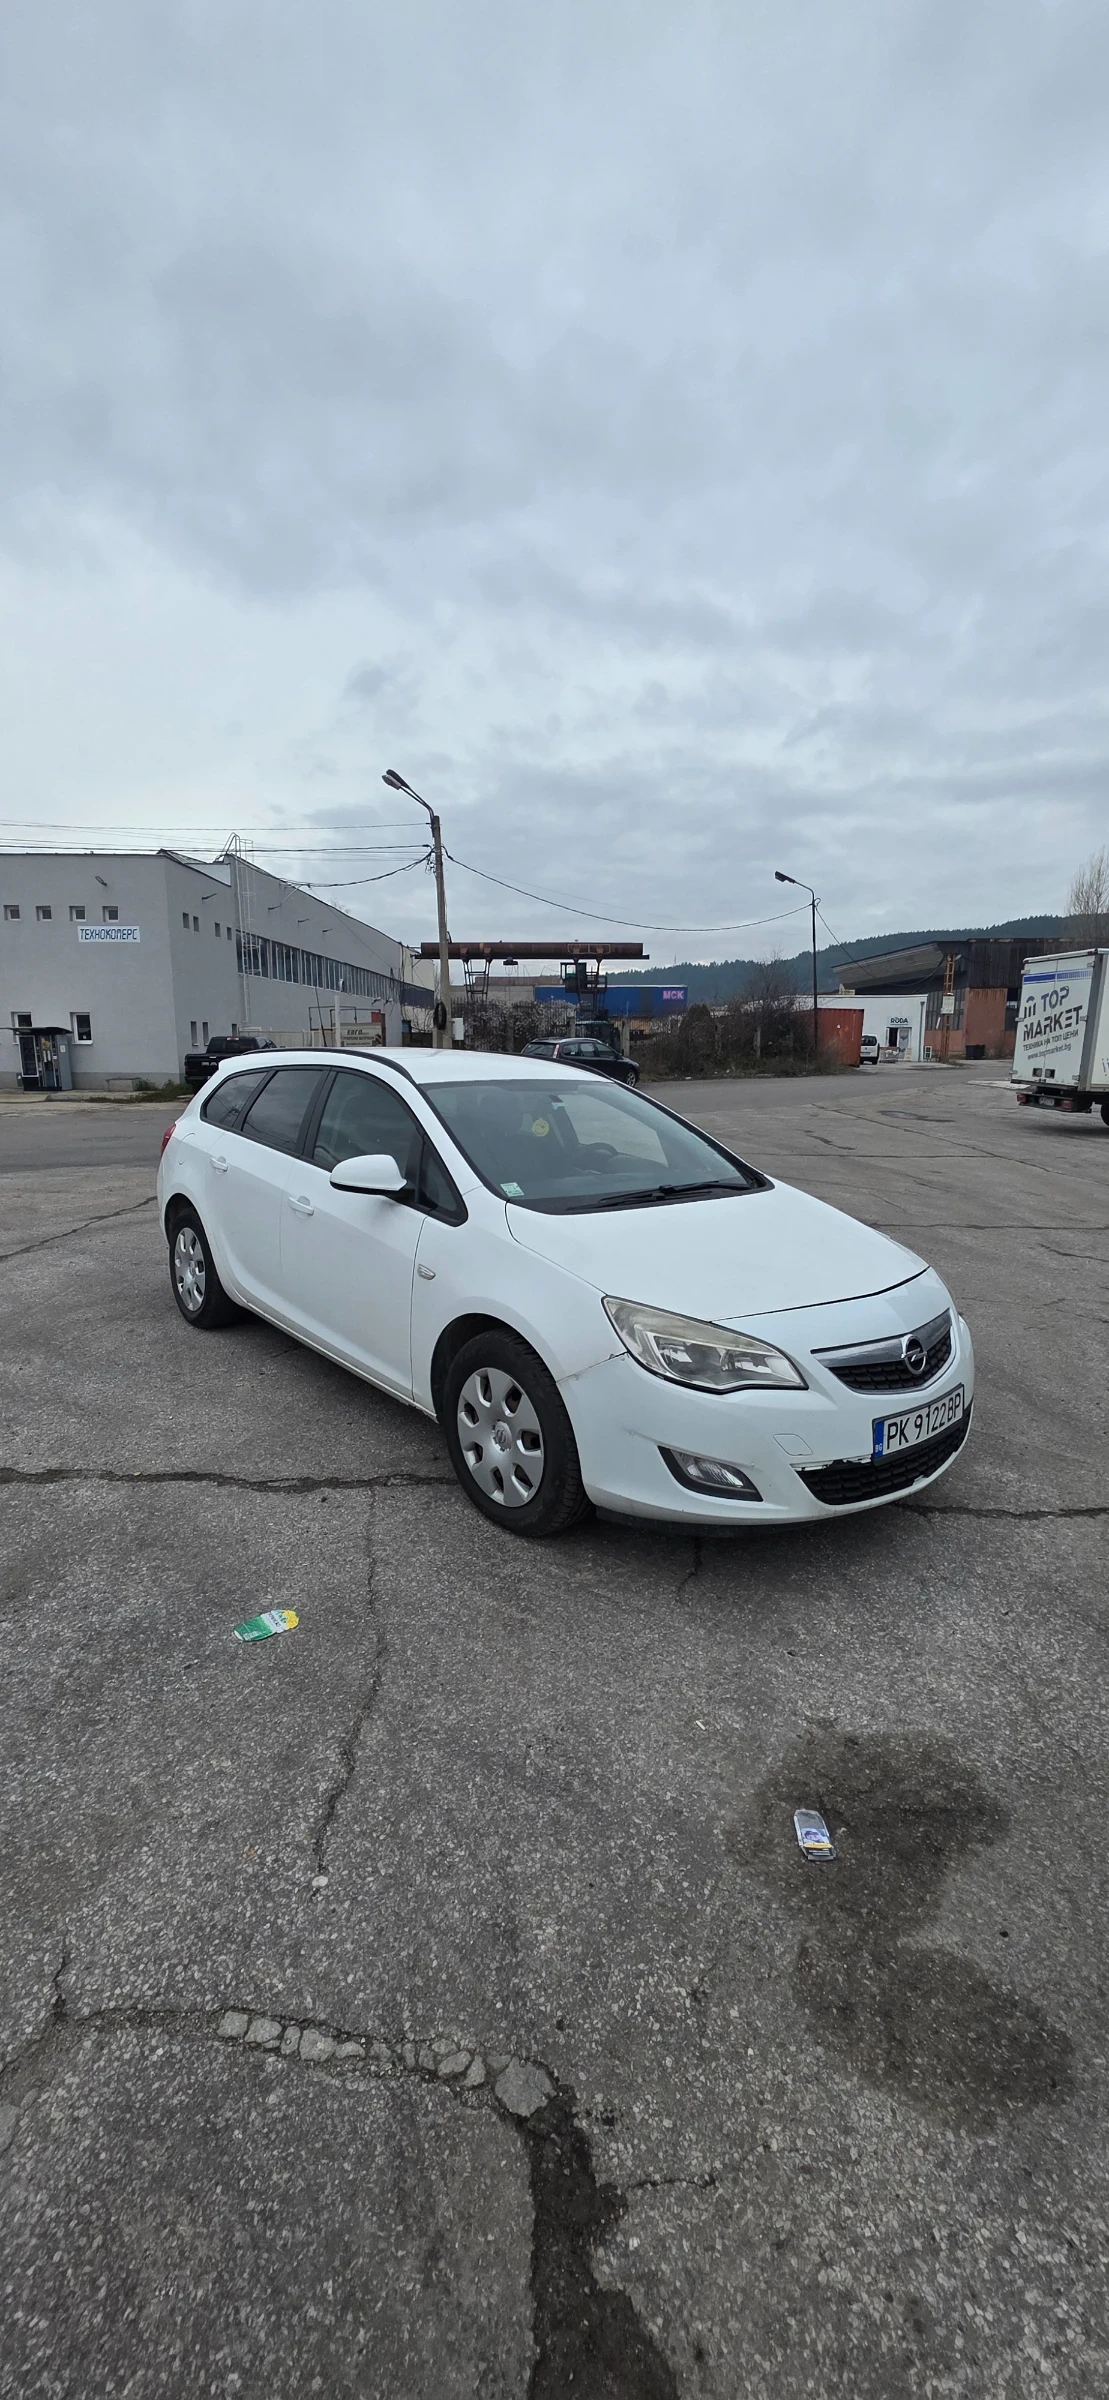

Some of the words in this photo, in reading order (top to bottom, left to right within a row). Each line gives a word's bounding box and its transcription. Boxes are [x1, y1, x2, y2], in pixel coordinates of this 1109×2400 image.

[80, 929, 138, 940] ТЕХНОКОПЕРС
[1041, 986, 1070, 1012] TOP
[1023, 1005, 1083, 1041] MARKET
[1052, 1034, 1062, 1043] ТОП
[1062, 1029, 1079, 1041] ЦЕНИ
[887, 1417, 910, 1450] PK
[875, 1443, 883, 1453] BG
